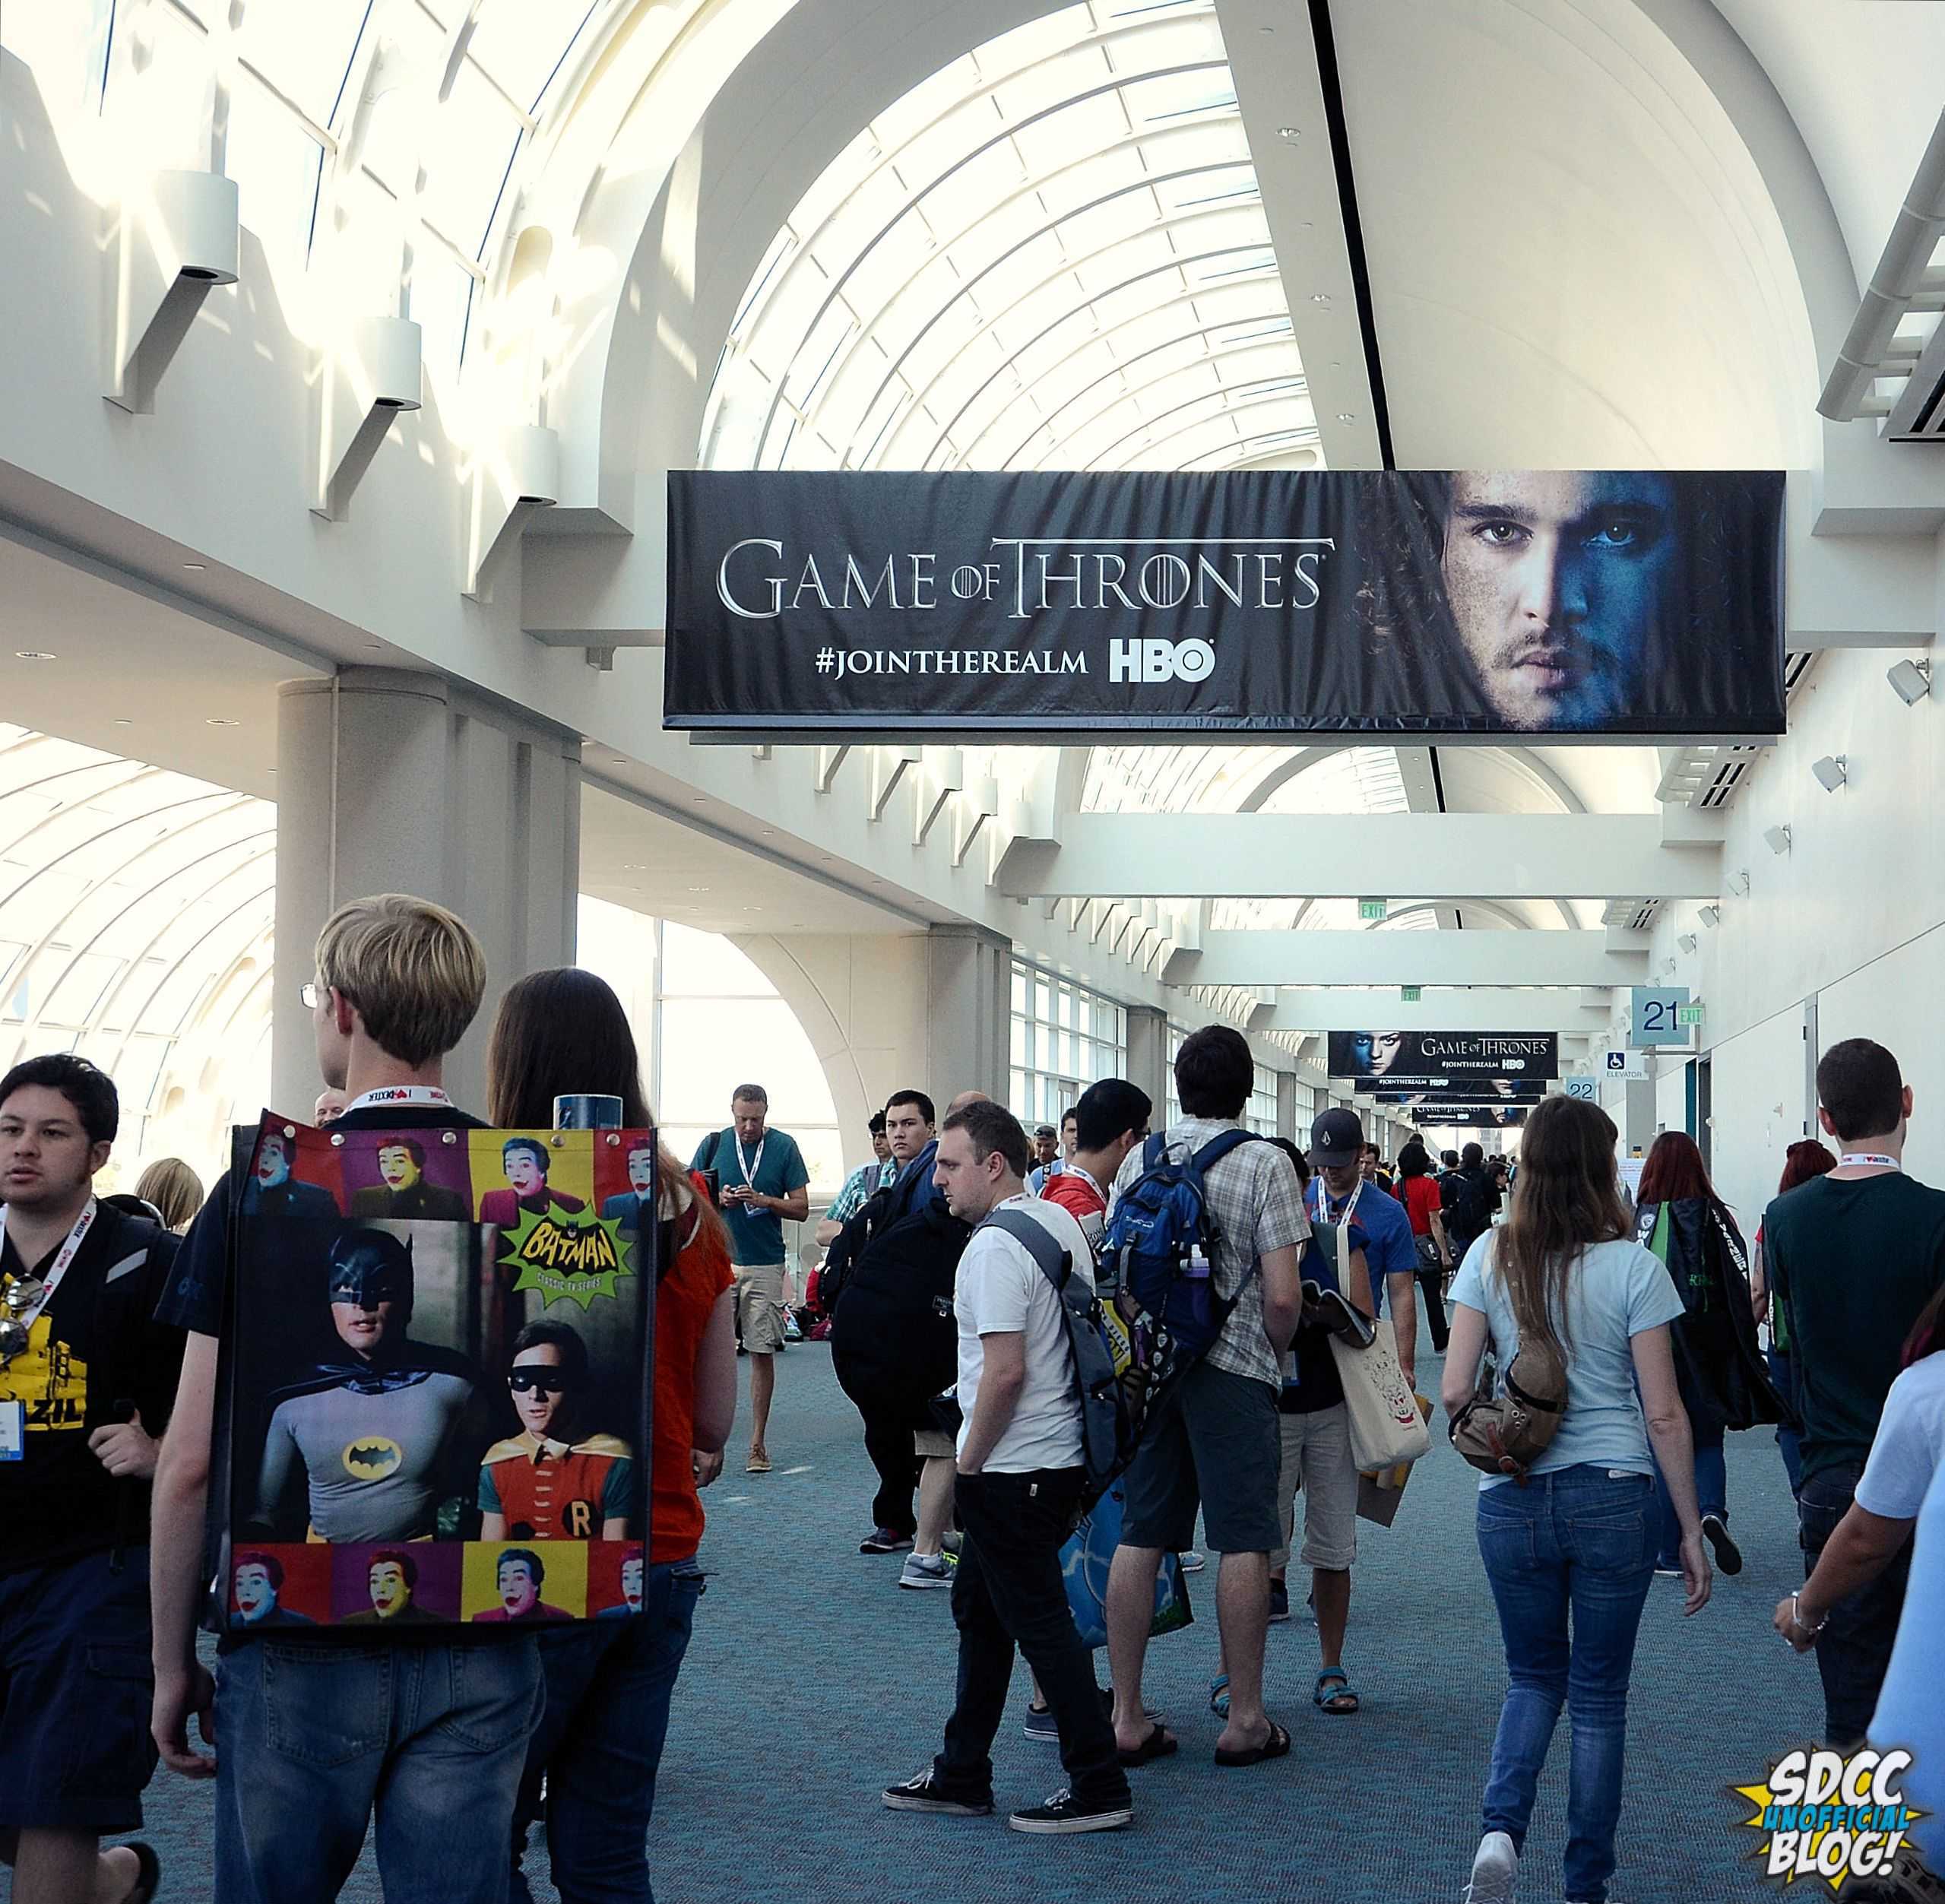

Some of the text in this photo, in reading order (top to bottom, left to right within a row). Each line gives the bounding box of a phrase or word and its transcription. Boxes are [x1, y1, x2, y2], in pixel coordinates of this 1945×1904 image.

[716, 537, 1335, 619] GAME OF THRONES
[815, 638, 1215, 683] #JOINTHEREALM HBO
[1362, 904, 1383, 918] EXIT
[1643, 1000, 1677, 1031] 21
[1680, 1009, 1701, 1023] EXIT
[1421, 1038, 1550, 1056] GAME OF THRONES
[1502, 1059, 1525, 1069] HBO
[368, 1089, 394, 1101] DEXTER
[1570, 1083, 1592, 1099] 22
[523, 1222, 616, 1270] BATMAN
[572, 1500, 591, 1536] R
